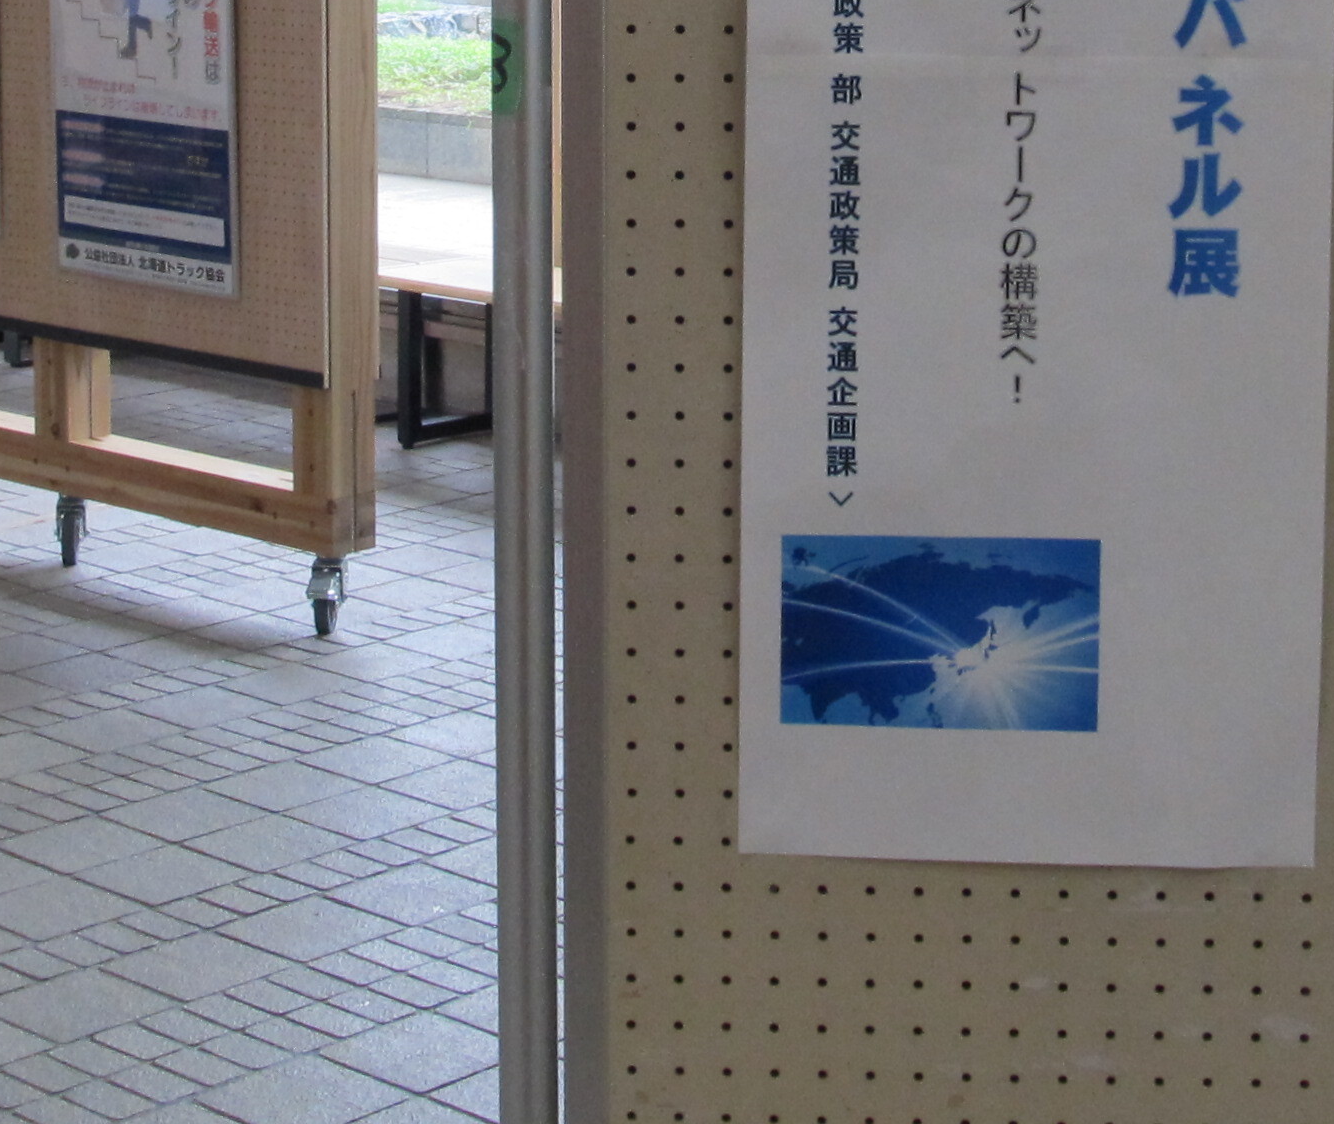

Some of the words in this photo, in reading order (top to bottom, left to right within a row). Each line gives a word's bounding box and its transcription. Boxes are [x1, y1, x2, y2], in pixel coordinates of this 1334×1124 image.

[828, 120, 862, 291] 交通政策局
[138, 255, 226, 284] 北海道トラック協会
